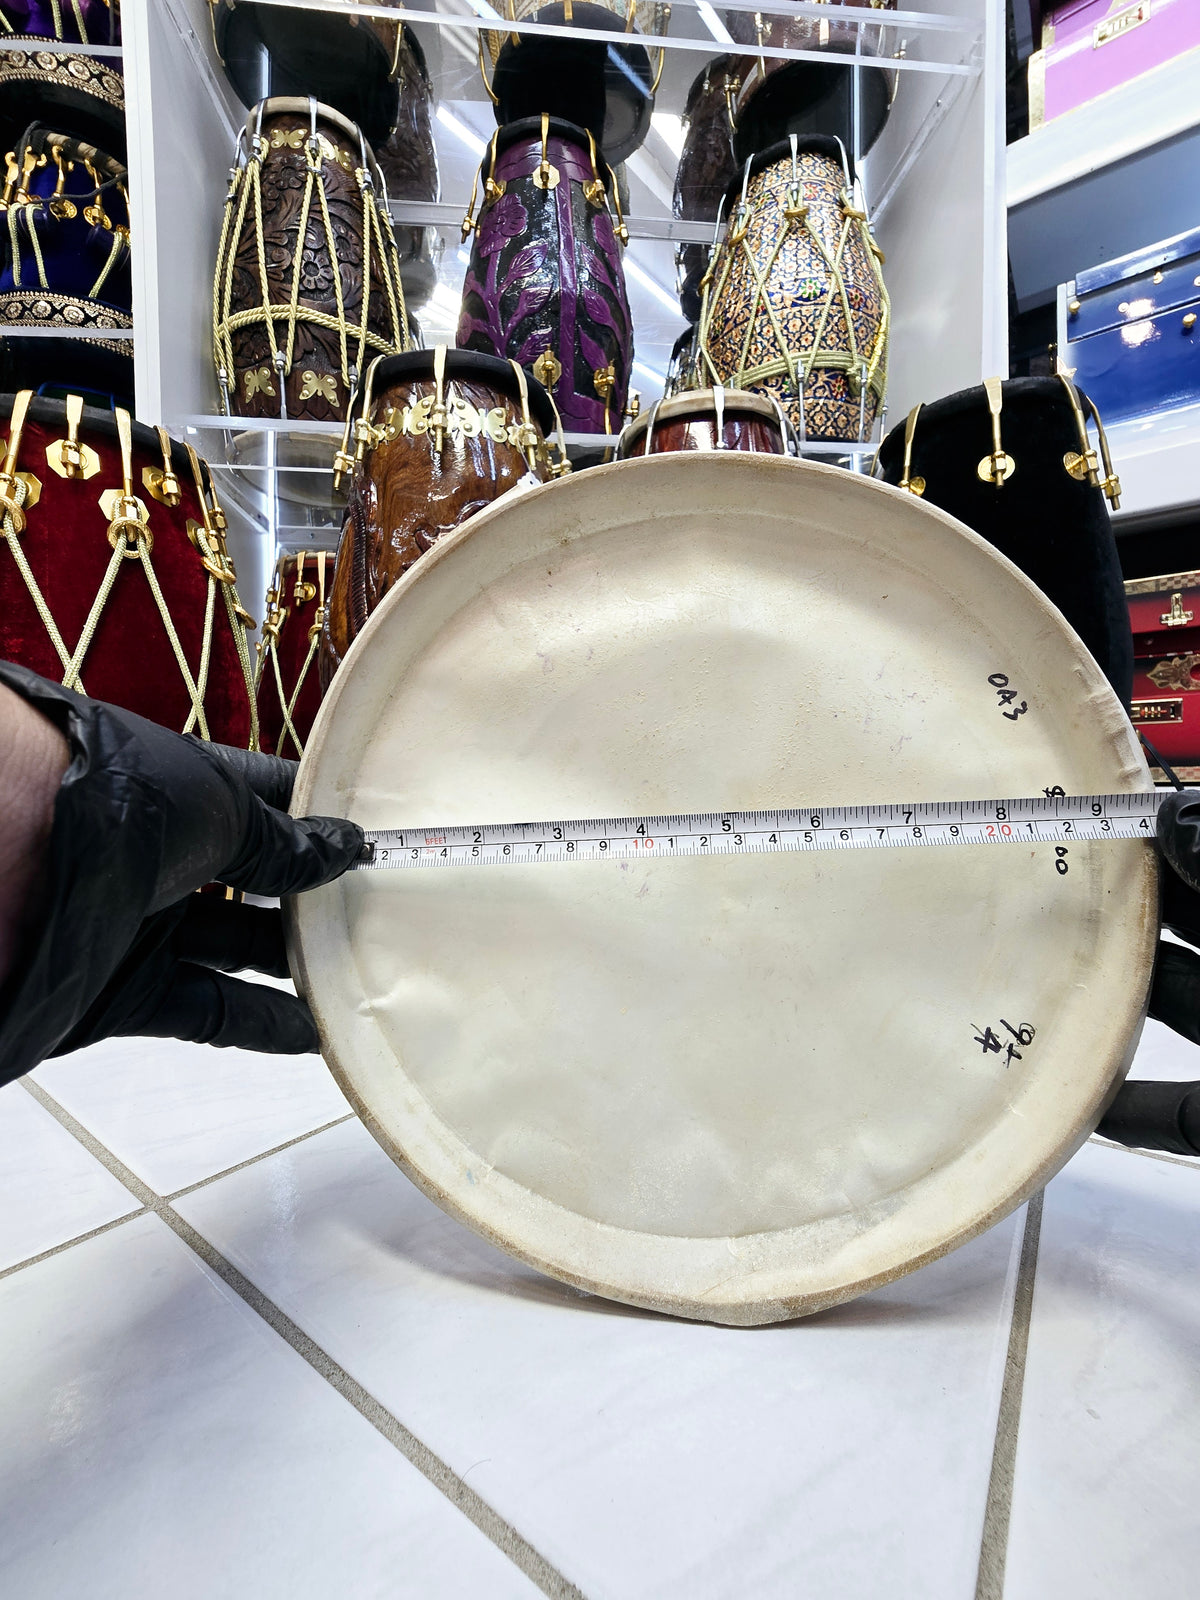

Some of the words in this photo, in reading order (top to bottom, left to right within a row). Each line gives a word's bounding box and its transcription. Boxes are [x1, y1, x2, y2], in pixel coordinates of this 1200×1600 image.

[381, 850, 389, 860] 2
[411, 848, 419, 860] 3
[440, 848, 448, 858] 4
[472, 846, 480, 857] 5
[503, 844, 511, 855] 6
[535, 844, 543, 854] 7
[566, 842, 575, 852] 8
[599, 840, 608, 852] 9
[632, 838, 654, 850] 10
[668, 838, 674, 848] 1
[700, 836, 708, 847] 2
[734, 834, 743, 846] 3
[768, 834, 778, 844] 4
[804, 832, 813, 843] 5
[840, 830, 849, 840] 6
[876, 828, 885, 840] 7
[913, 827, 922, 838] 8
[950, 825, 960, 837] 9
[986, 824, 1012, 837] 20
[1026, 822, 1034, 834] 1
[1063, 822, 1074, 833] 2
[1100, 820, 1110, 832] 3
[1138, 818, 1150, 830] 4
[397, 834, 404, 846] 1
[474, 832, 482, 844] 2
[552, 827, 562, 840] 3
[636, 823, 646, 836] 4
[722, 820, 732, 832] 5
[810, 815, 821, 828] 6
[902, 811, 913, 824] 7
[996, 807, 1007, 820] 8
[1092, 803, 1102, 817] 9
